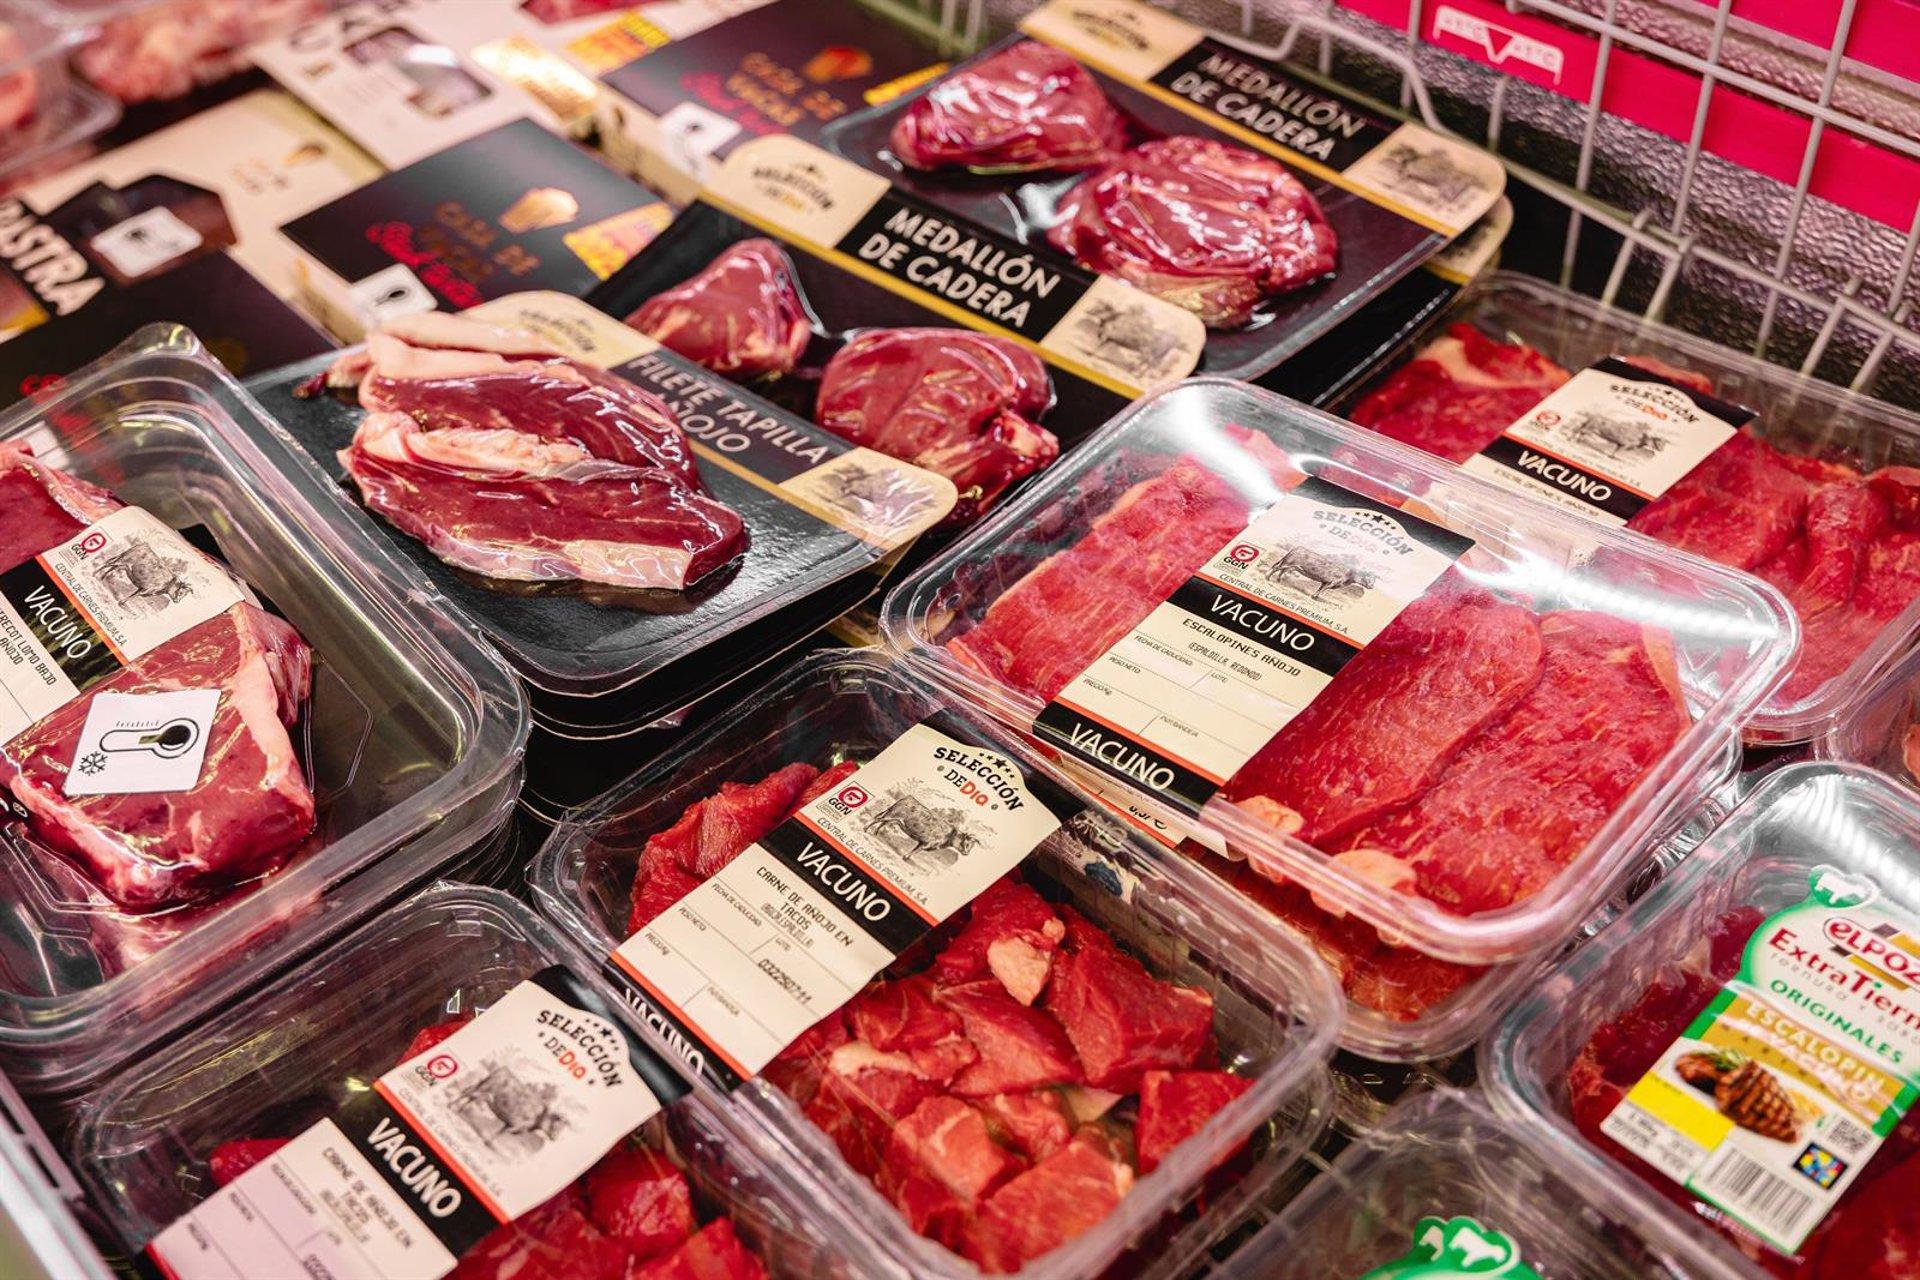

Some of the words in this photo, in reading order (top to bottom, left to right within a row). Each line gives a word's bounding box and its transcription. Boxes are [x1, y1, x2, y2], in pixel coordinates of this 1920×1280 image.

[1170, 71, 1222, 104] DE
[1215, 93, 1336, 162] CADERA
[857, 232, 903, 274] DE
[905, 255, 1033, 328] CADERA
[884, 207, 1060, 299] MEDALLÓN
[626, 354, 723, 406] FILETE
[722, 398, 830, 464] TAPILLA
[1518, 450, 1612, 501] VACUNO
[1223, 556, 1249, 570] GGN
[1312, 510, 1414, 556] SELECCIÓN
[24, 585, 92, 659] VACUNO
[1210, 594, 1315, 651] VACUNO
[1219, 574, 1252, 590] CENTRAL
[1253, 586, 1266, 597] DE
[1264, 592, 1296, 609] CARNES
[17, 639, 40, 664] LOMO
[35, 662, 57, 686] BAJO
[1182, 618, 1260, 659] ESCALOPINES
[1261, 651, 1302, 677] AÑOJO
[934, 746, 1024, 811] SELECCIÓN
[1070, 722, 1175, 791] VACUNO
[828, 797, 852, 816] GGN
[817, 817, 846, 842] CENTRAL
[846, 839, 857, 850] DE
[855, 846, 882, 869] CARNES
[757, 866, 791, 895] CARNE
[788, 892, 804, 906] DE
[835, 931, 854, 947] EN
[797, 842, 892, 921] VACUNO
[780, 902, 811, 930] TACOS
[536, 1009, 623, 1088] SELECCIÓN
[1770, 979, 1903, 1064] ORIGINALES
[367, 1117, 462, 1218] VACUNO
